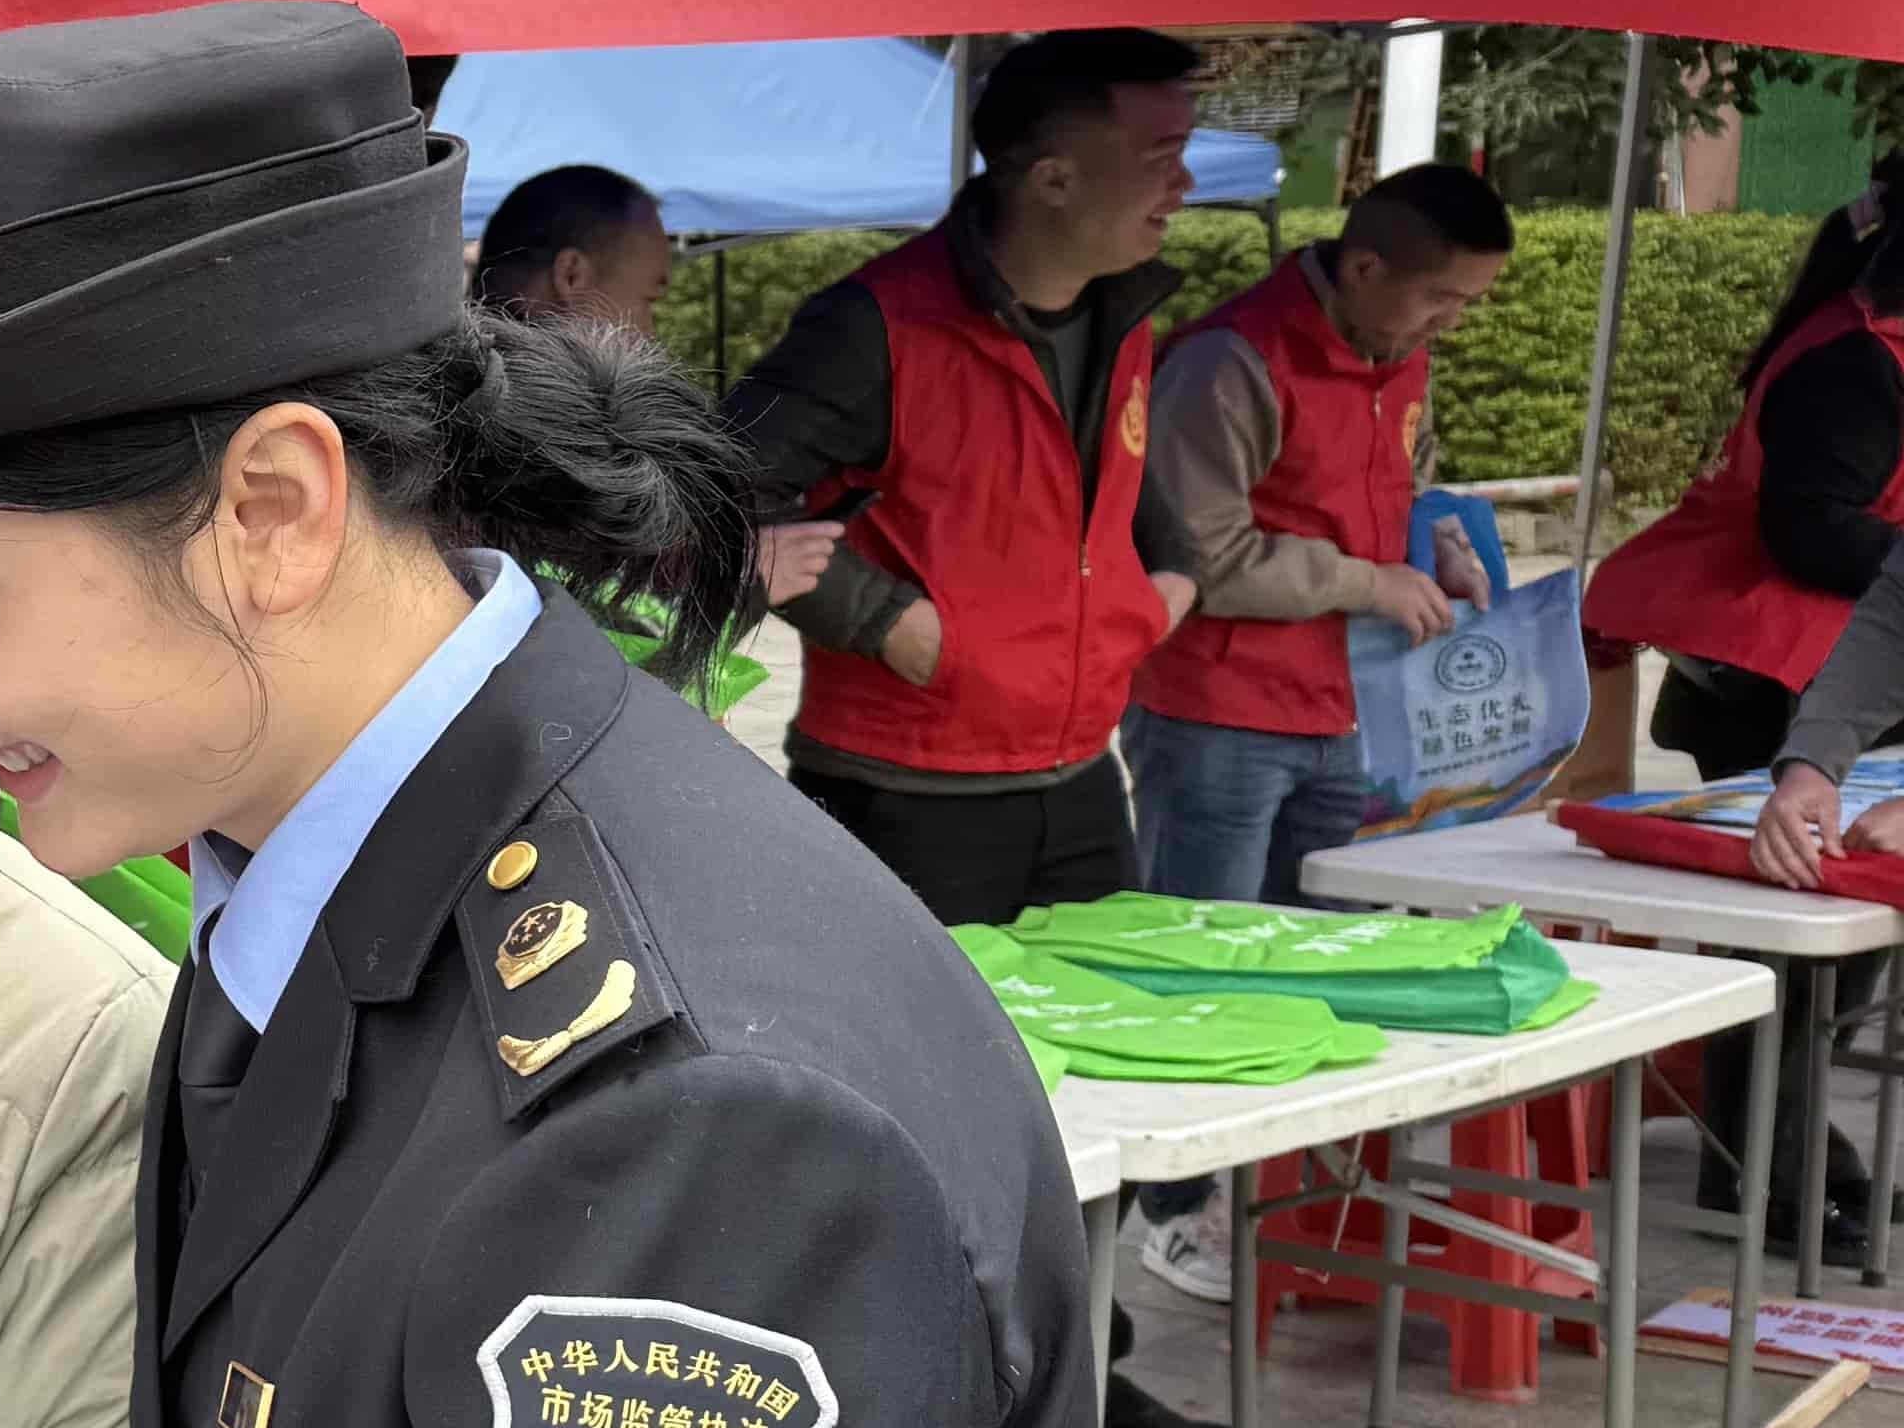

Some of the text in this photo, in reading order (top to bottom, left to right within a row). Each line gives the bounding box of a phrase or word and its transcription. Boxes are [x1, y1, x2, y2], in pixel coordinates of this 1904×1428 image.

[521, 1339, 800, 1421] 中华人民共和国
